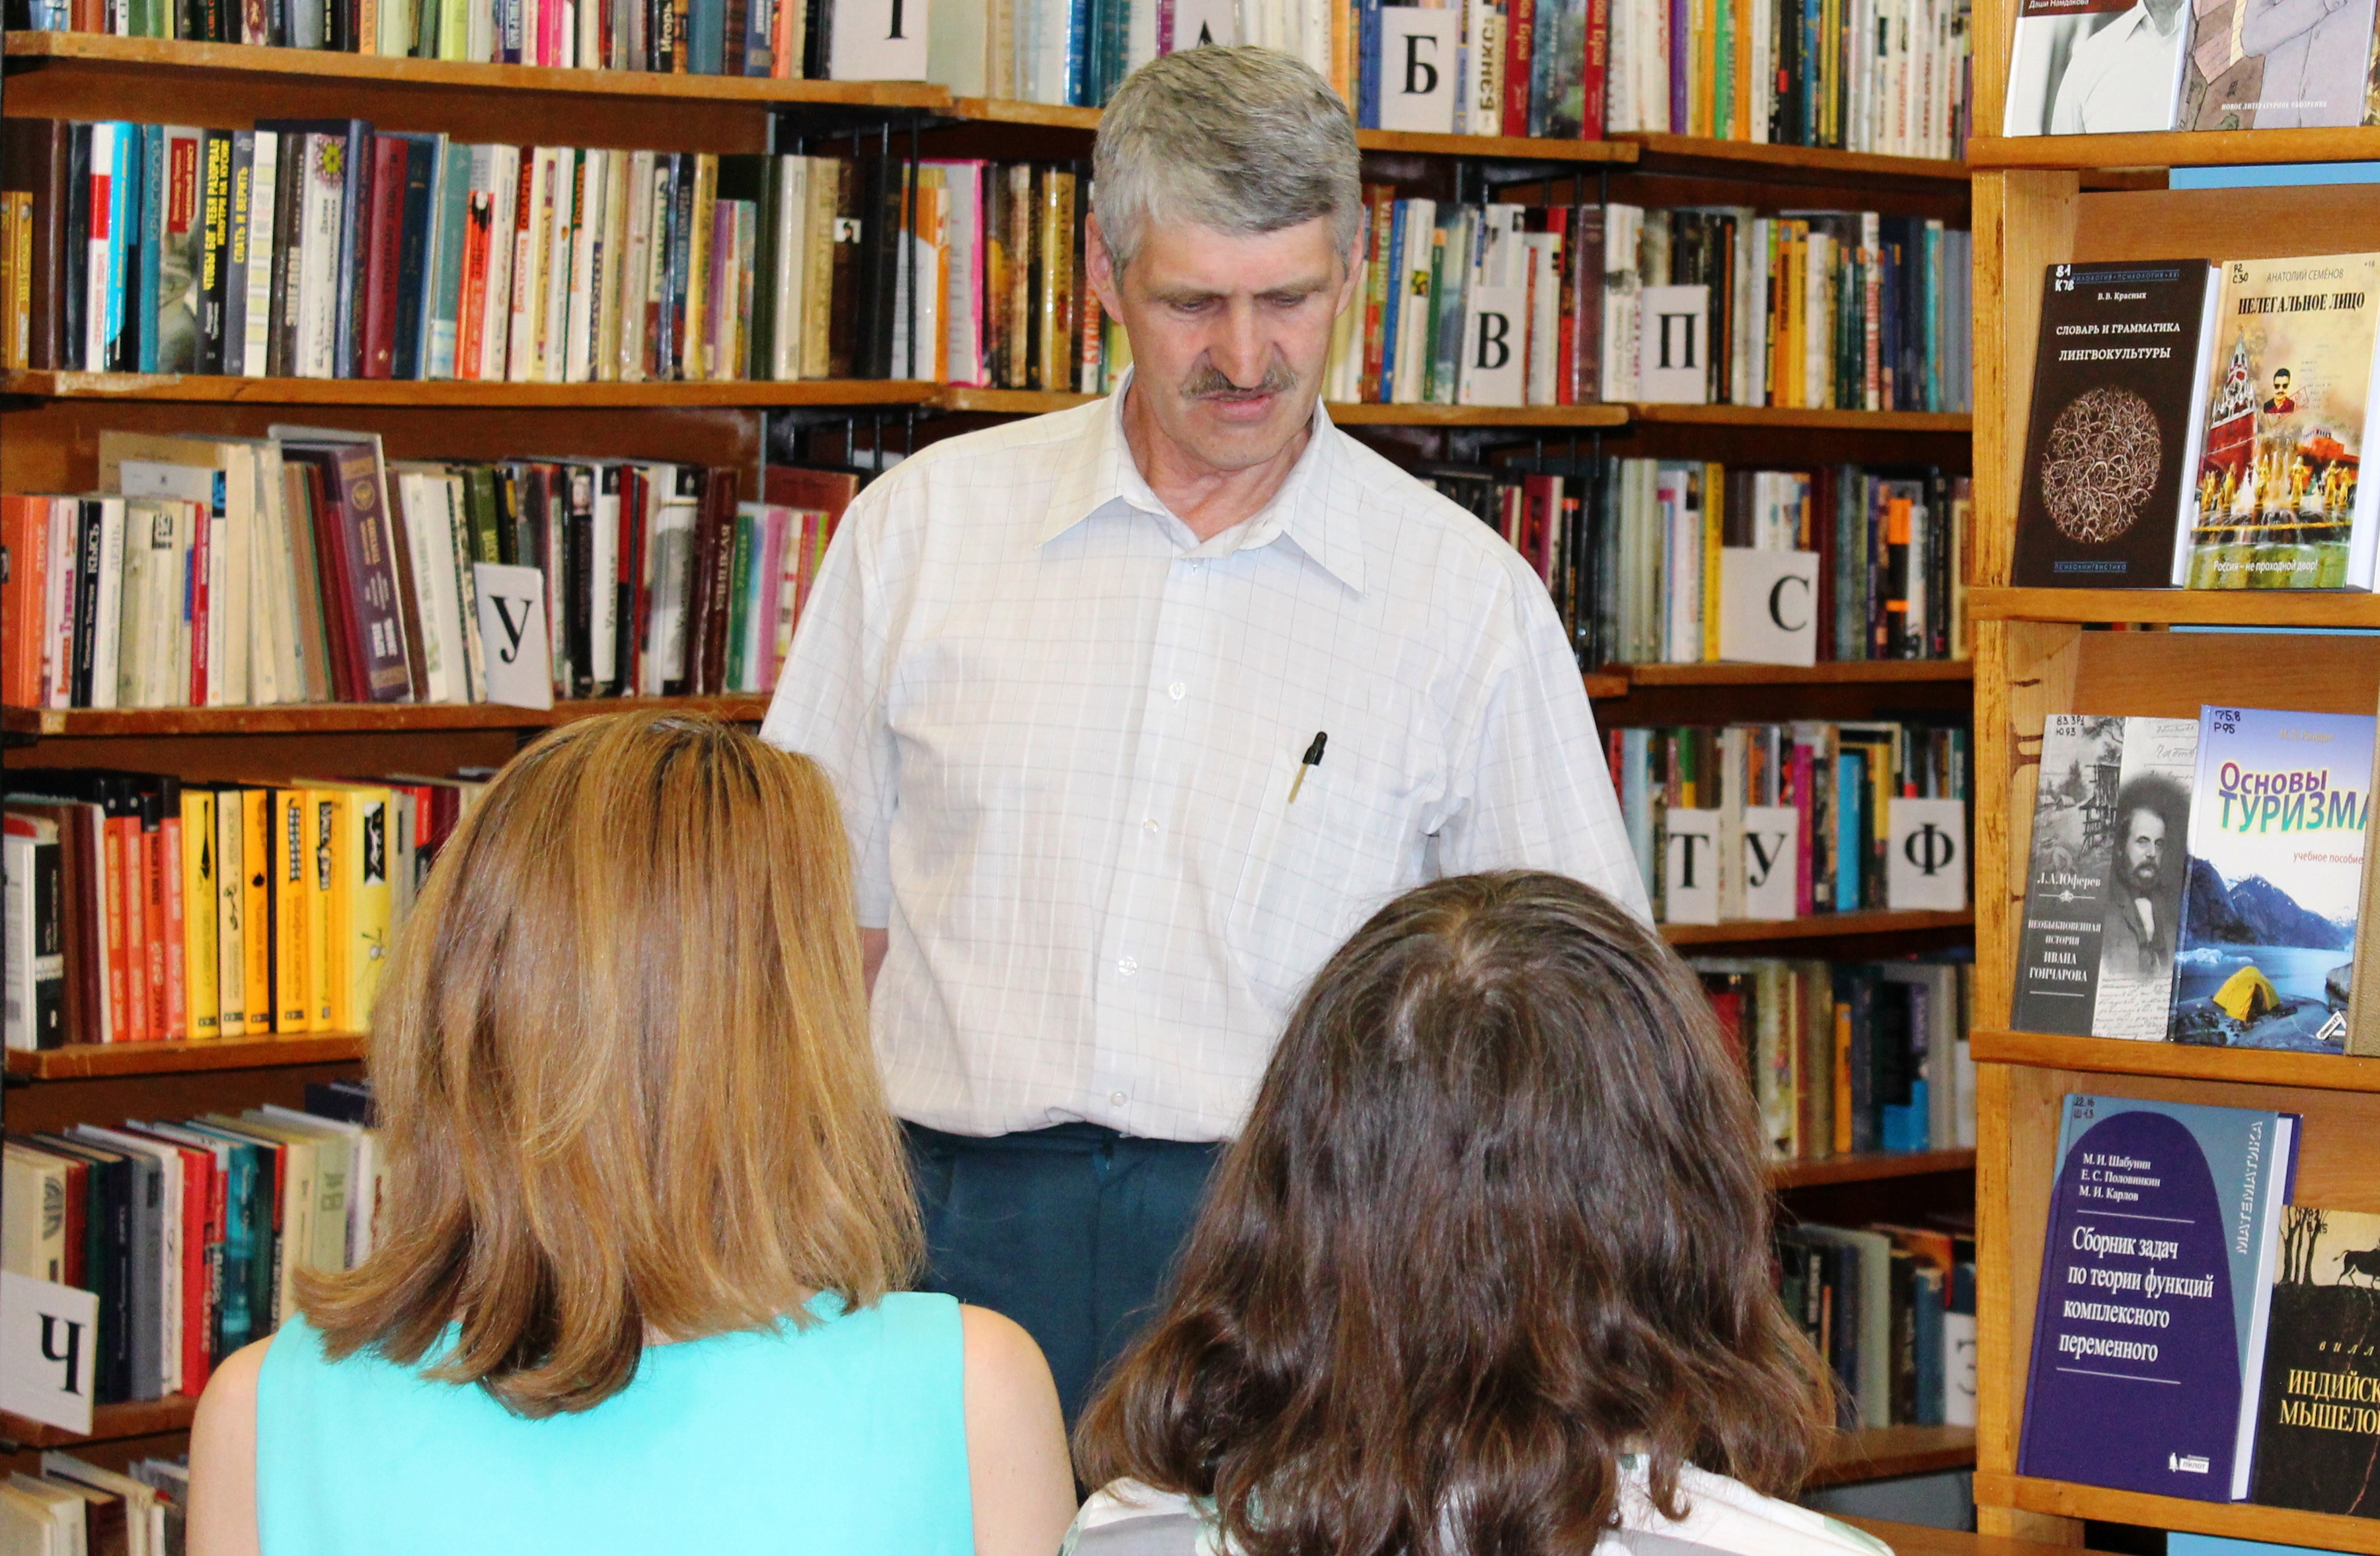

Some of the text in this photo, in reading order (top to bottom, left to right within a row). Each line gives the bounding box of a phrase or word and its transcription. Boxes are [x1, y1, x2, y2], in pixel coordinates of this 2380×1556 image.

[1402, 34, 1438, 93] Б
[205, 197, 217, 225] ТЕБЯ
[233, 166, 249, 263] СПАТЬ И ВЕРИТЬ
[204, 229, 216, 251] БОГ
[202, 252, 215, 291] ЧТОБЫ
[2055, 264, 2071, 278] 81
[2266, 268, 2344, 283] АНАТОЛИЙ СЕМЁНОВ
[2114, 292, 2147, 302] Красных
[2238, 292, 2365, 315] НЕЛЕГАЛЬНОЕ ЛИЦО
[1474, 313, 1510, 369] В
[1658, 313, 1699, 369] П
[2056, 323, 2180, 336] СЛОВАРЬ И ГРАММАТИКА
[2059, 348, 2172, 362] ЛИНГВОКУЛЬТУРЫ
[2213, 560, 2238, 572] Россия
[2245, 562, 2254, 570] не
[2256, 559, 2296, 574] проходной
[2297, 559, 2318, 572] двор!
[1769, 576, 1809, 632] С
[488, 596, 533, 664] У
[2221, 762, 2328, 795] Основы
[1670, 833, 1710, 888] Т
[1745, 832, 1788, 888] У
[1905, 824, 1955, 876] Ф
[2293, 851, 2363, 865] учебное пособие
[2028, 919, 2101, 933] НЕОБЫКНОВЕННАЯ
[2045, 935, 2080, 946] ИСТОРИЯ
[2043, 951, 2077, 964] ИВАНА
[2028, 967, 2087, 982] ГОНЧАРОВА
[2083, 1153, 2151, 1172] М. И. Шабунин
[2081, 1169, 2161, 1188] Е. С. Половинкин
[2235, 1121, 2263, 1255] МАТЕМАТИКА
[2079, 1185, 2139, 1202] М. И. Карлов
[2072, 1225, 2178, 1261] Сборник задач
[2067, 1266, 2214, 1298] по теории функций
[2063, 1300, 2170, 1329] комплексного
[38, 1312, 87, 1396] Ч
[2059, 1334, 2159, 1362] переменного
